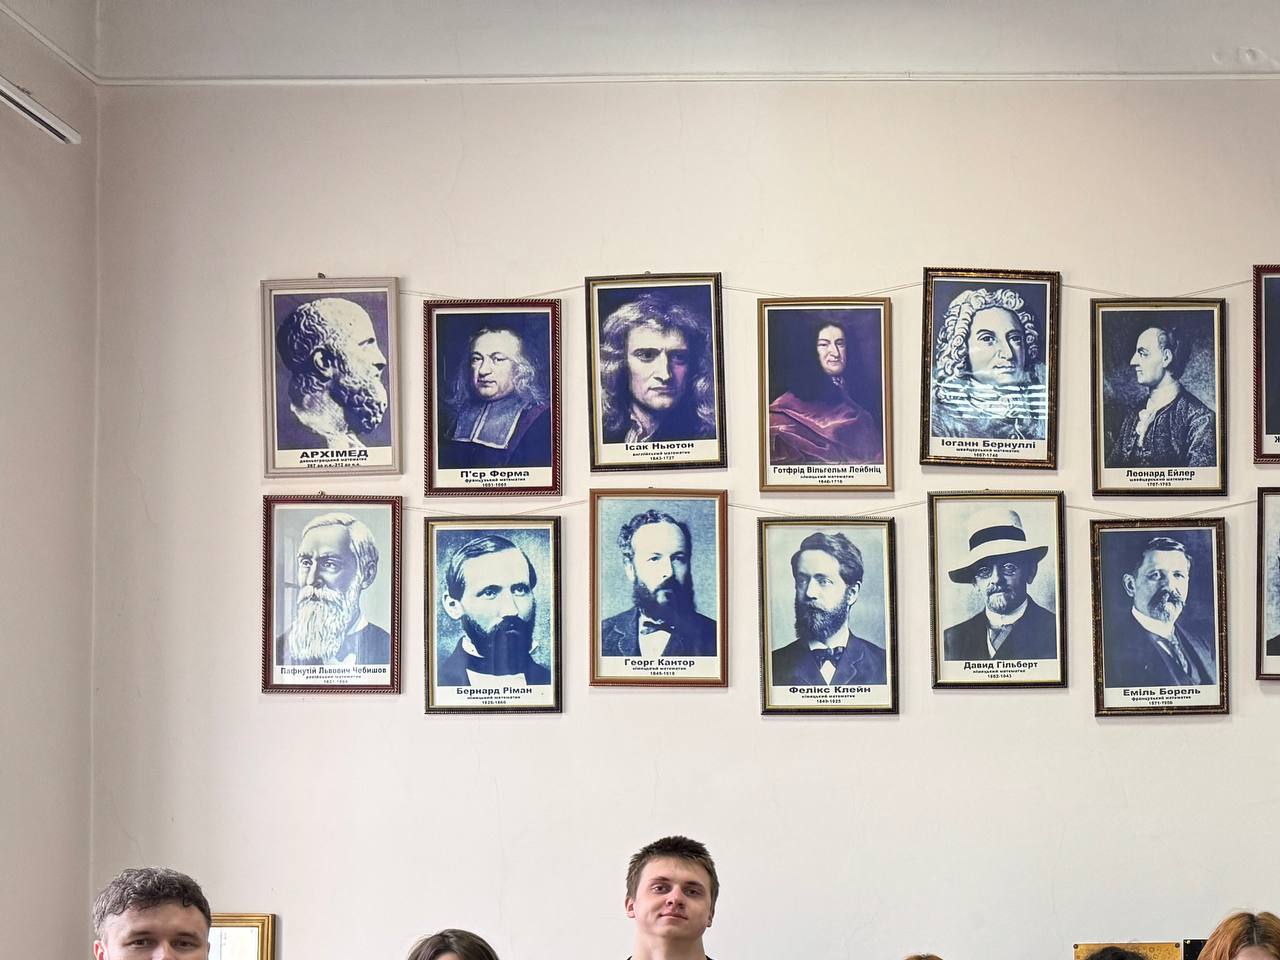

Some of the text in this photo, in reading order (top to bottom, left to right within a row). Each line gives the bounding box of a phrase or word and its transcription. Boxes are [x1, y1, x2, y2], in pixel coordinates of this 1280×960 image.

[625, 442, 695, 451] Ісак Ньютон
[941, 439, 1036, 450] Іоганн Бернуллі
[300, 450, 369, 460] АРХІМЕД
[460, 470, 530, 479] П'єр Ферма
[773, 466, 881, 475] Готфрід Вільгельм Лейбніц
[1126, 469, 1195, 479] Леонард Ейлер
[624, 659, 695, 667] Георг Кантор
[964, 660, 1038, 670] Давид Гільберт
[280, 667, 317, 675] Пафнутій
[456, 686, 533, 696] Бернард Ріман
[789, 685, 871, 695] Фелікс Клейн
[1123, 688, 1201, 697] Еміль Борель
